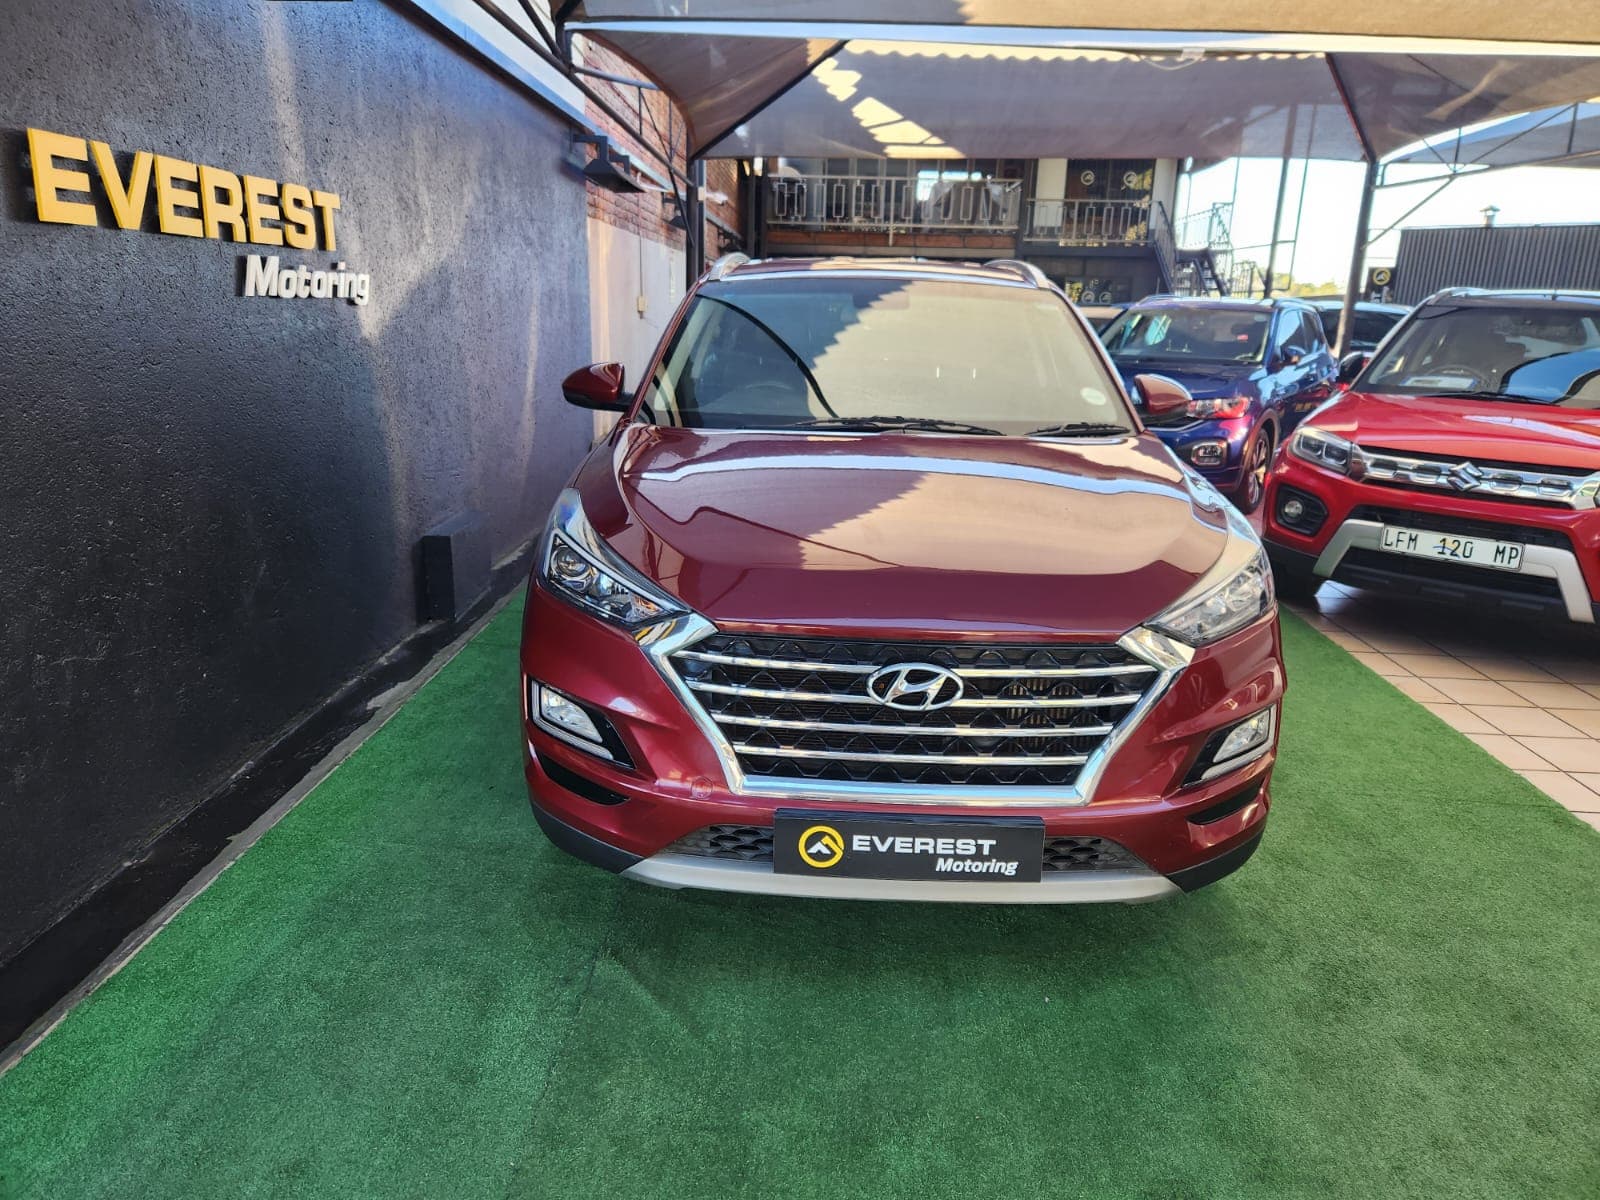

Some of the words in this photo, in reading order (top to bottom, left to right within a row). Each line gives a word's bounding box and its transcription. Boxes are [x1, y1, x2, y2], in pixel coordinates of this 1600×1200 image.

[27, 128, 341, 251] EVEREST
[245, 254, 371, 306] Motoring
[1384, 529, 1418, 551] LFM
[1438, 537, 1474, 559] 120
[1494, 545, 1519, 565] MP
[852, 834, 996, 855] EVEREST
[935, 857, 1018, 875] Motoring
